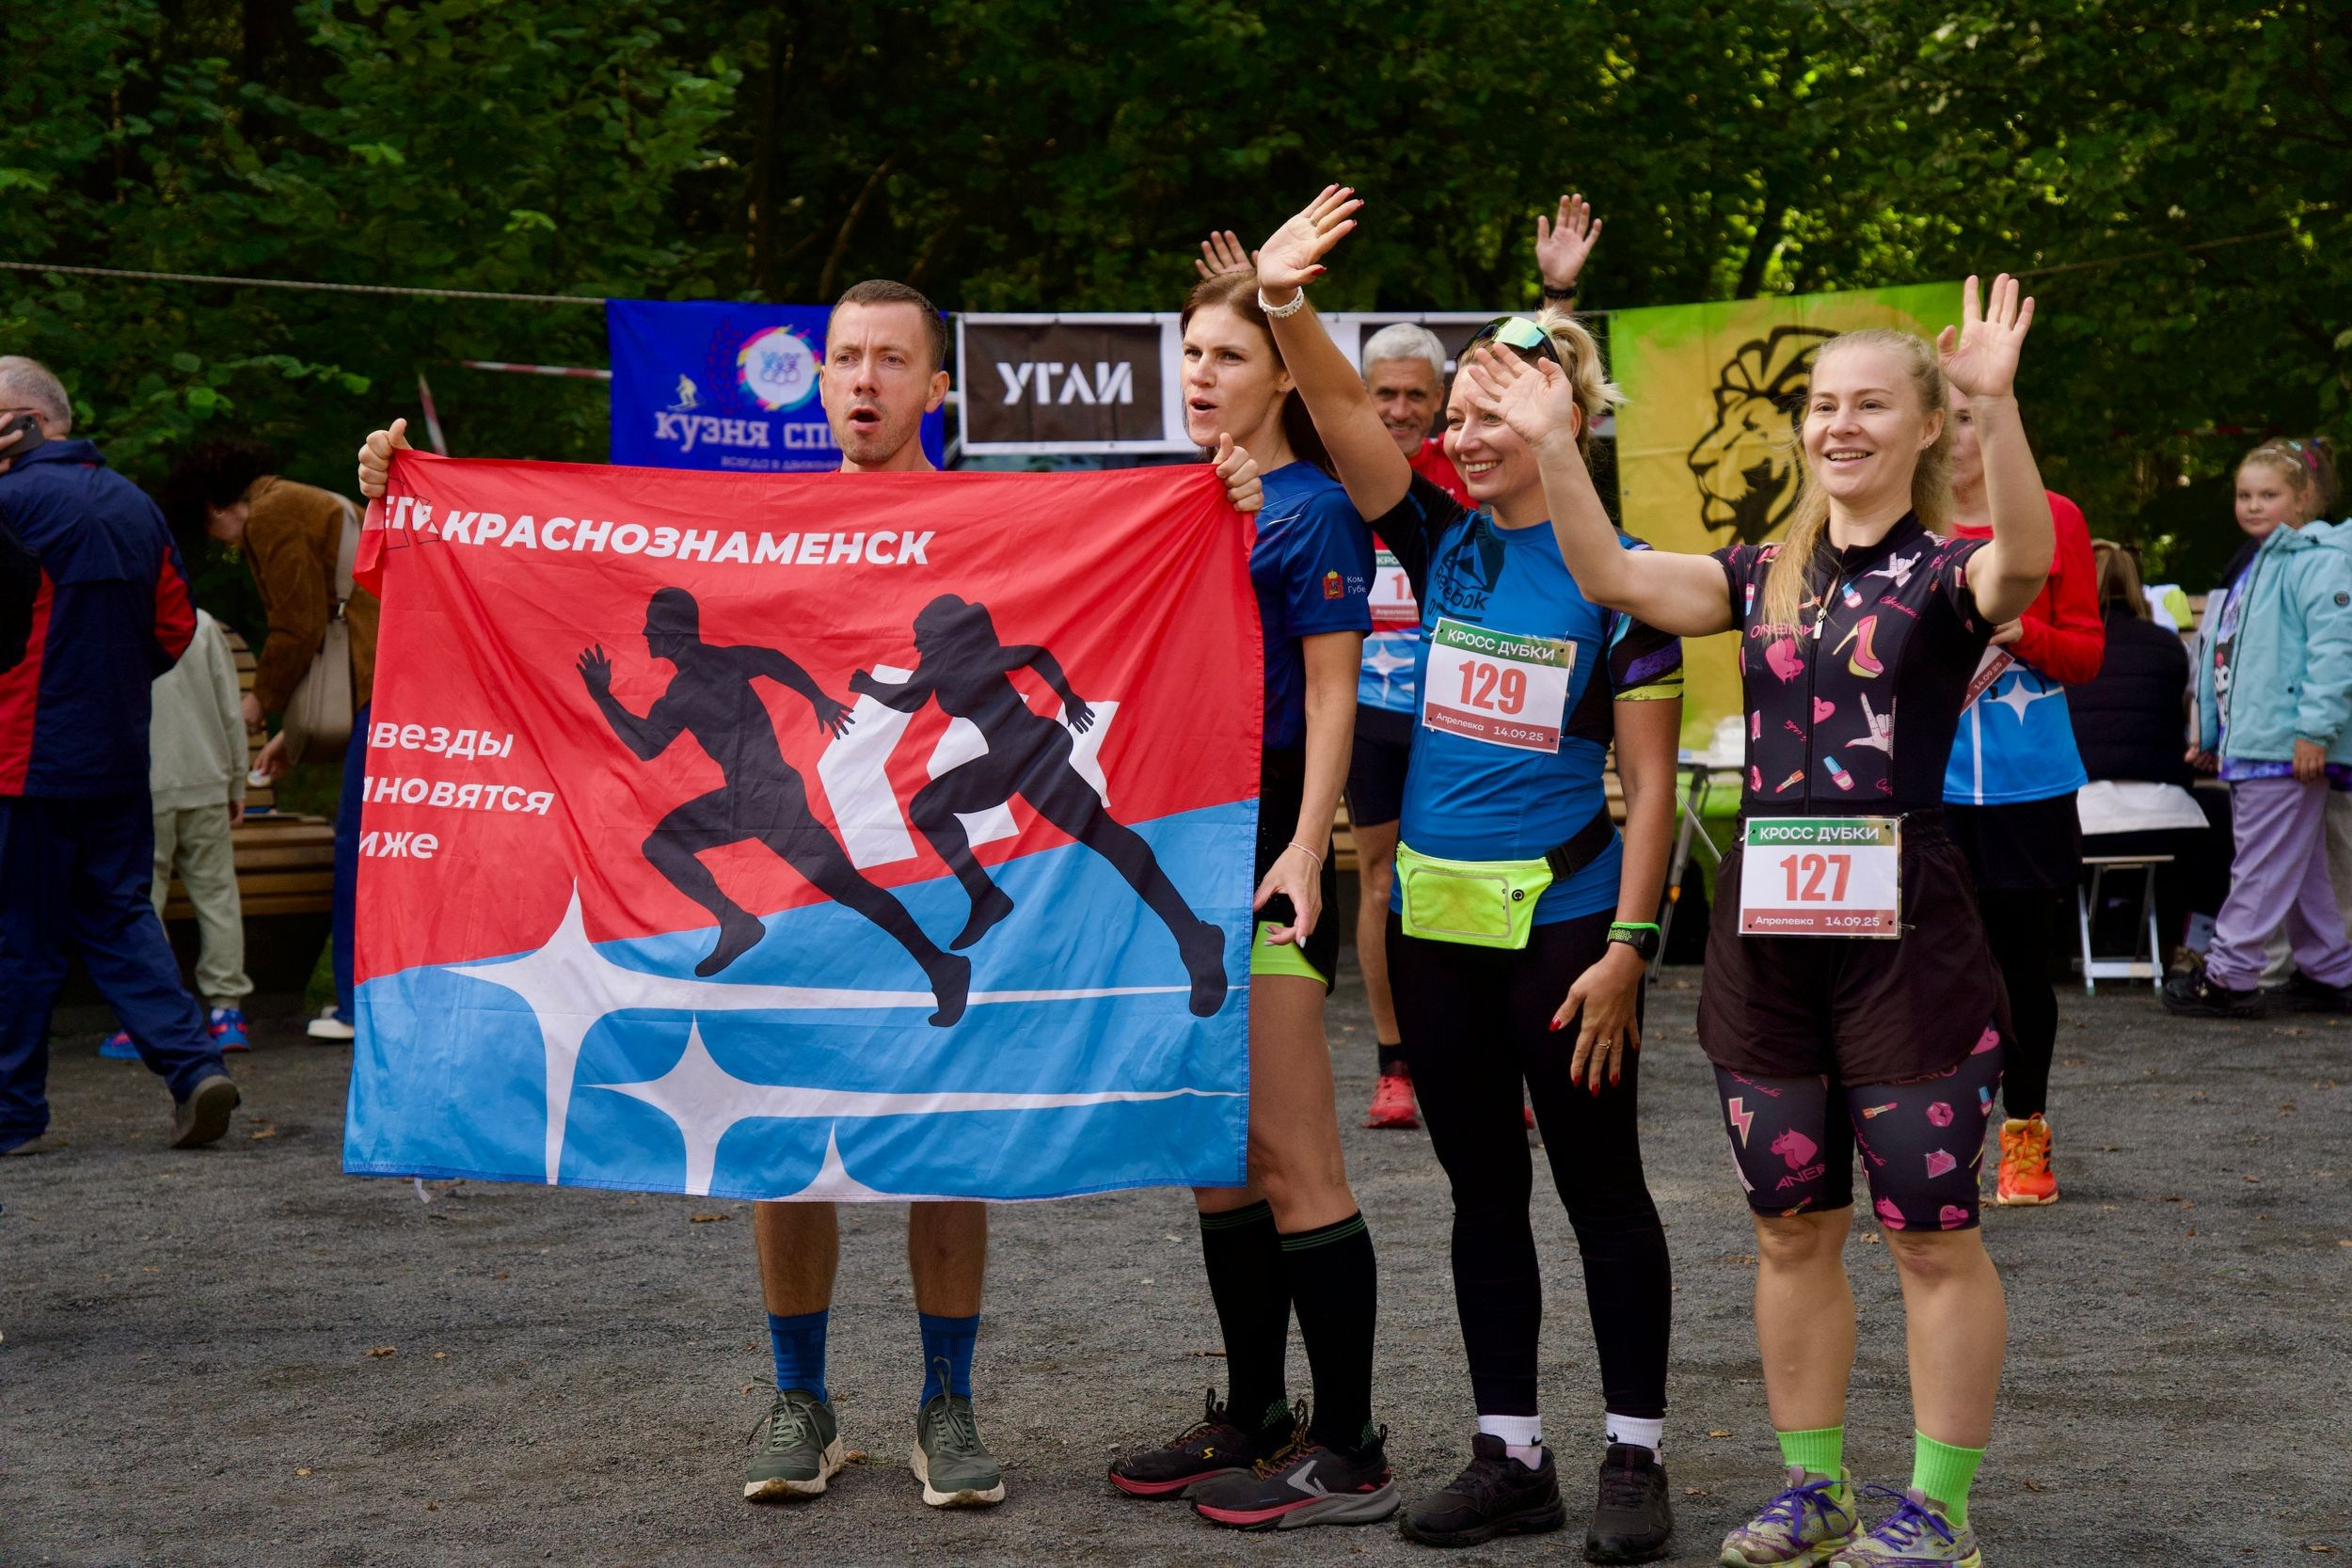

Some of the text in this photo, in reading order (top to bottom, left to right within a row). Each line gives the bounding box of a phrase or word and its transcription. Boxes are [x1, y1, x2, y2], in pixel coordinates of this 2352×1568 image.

[996, 361, 1133, 404] УГЛИ
[441, 510, 935, 565] КРАСНОЗНАМЕНСК
[1447, 628, 1555, 661] КРОСС ДУБКИ
[1459, 659, 1527, 715] 129
[367, 721, 514, 760] везды
[1436, 711, 1544, 742] Апрелевка 14.09.25
[1759, 827, 1880, 842] КРОСС ДУБКИ
[1780, 853, 1851, 902] 127
[1756, 915, 1880, 927] Апрелевка 14.09.25
